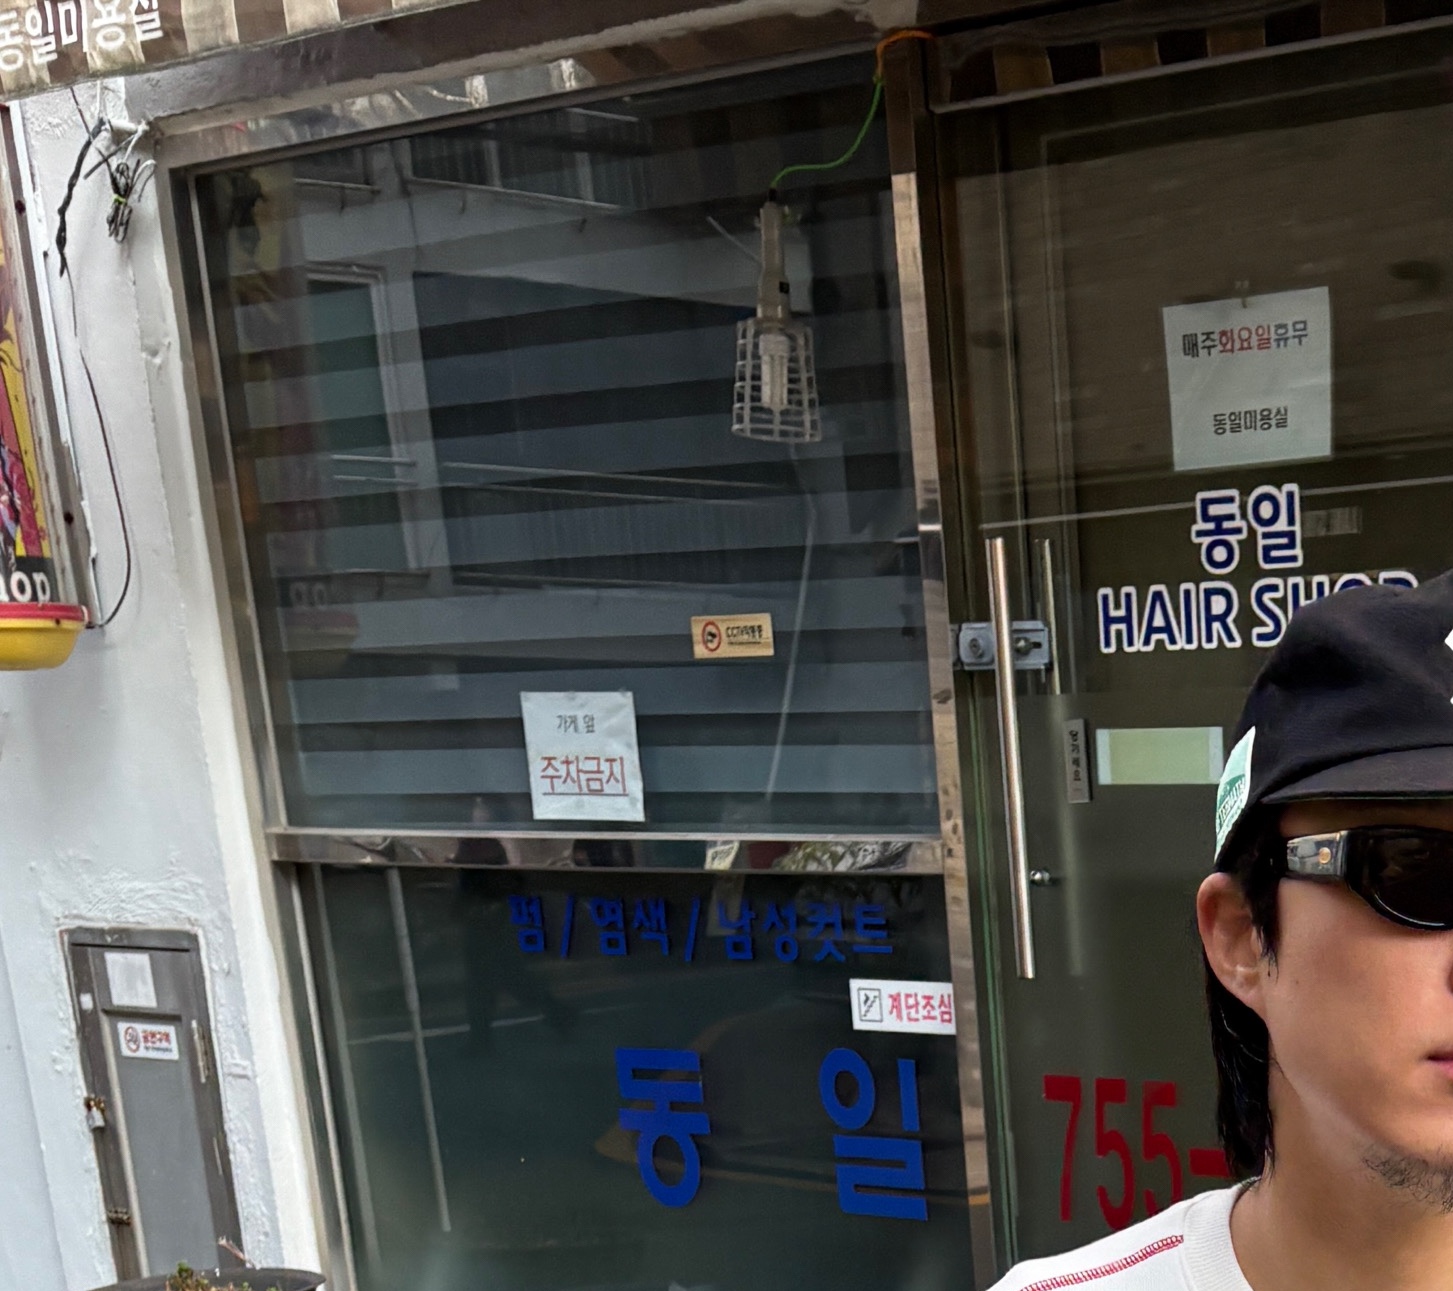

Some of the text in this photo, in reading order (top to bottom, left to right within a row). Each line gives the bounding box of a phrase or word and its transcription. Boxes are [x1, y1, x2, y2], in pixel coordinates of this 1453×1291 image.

[1212, 405, 1289, 436] 동일미용실
[1191, 483, 1303, 574] 동일
[1097, 580, 1242, 654] HAIR
[556, 714, 580, 733] 가게
[540, 755, 627, 794] 주차금지
[887, 991, 953, 1024] 계단조심
